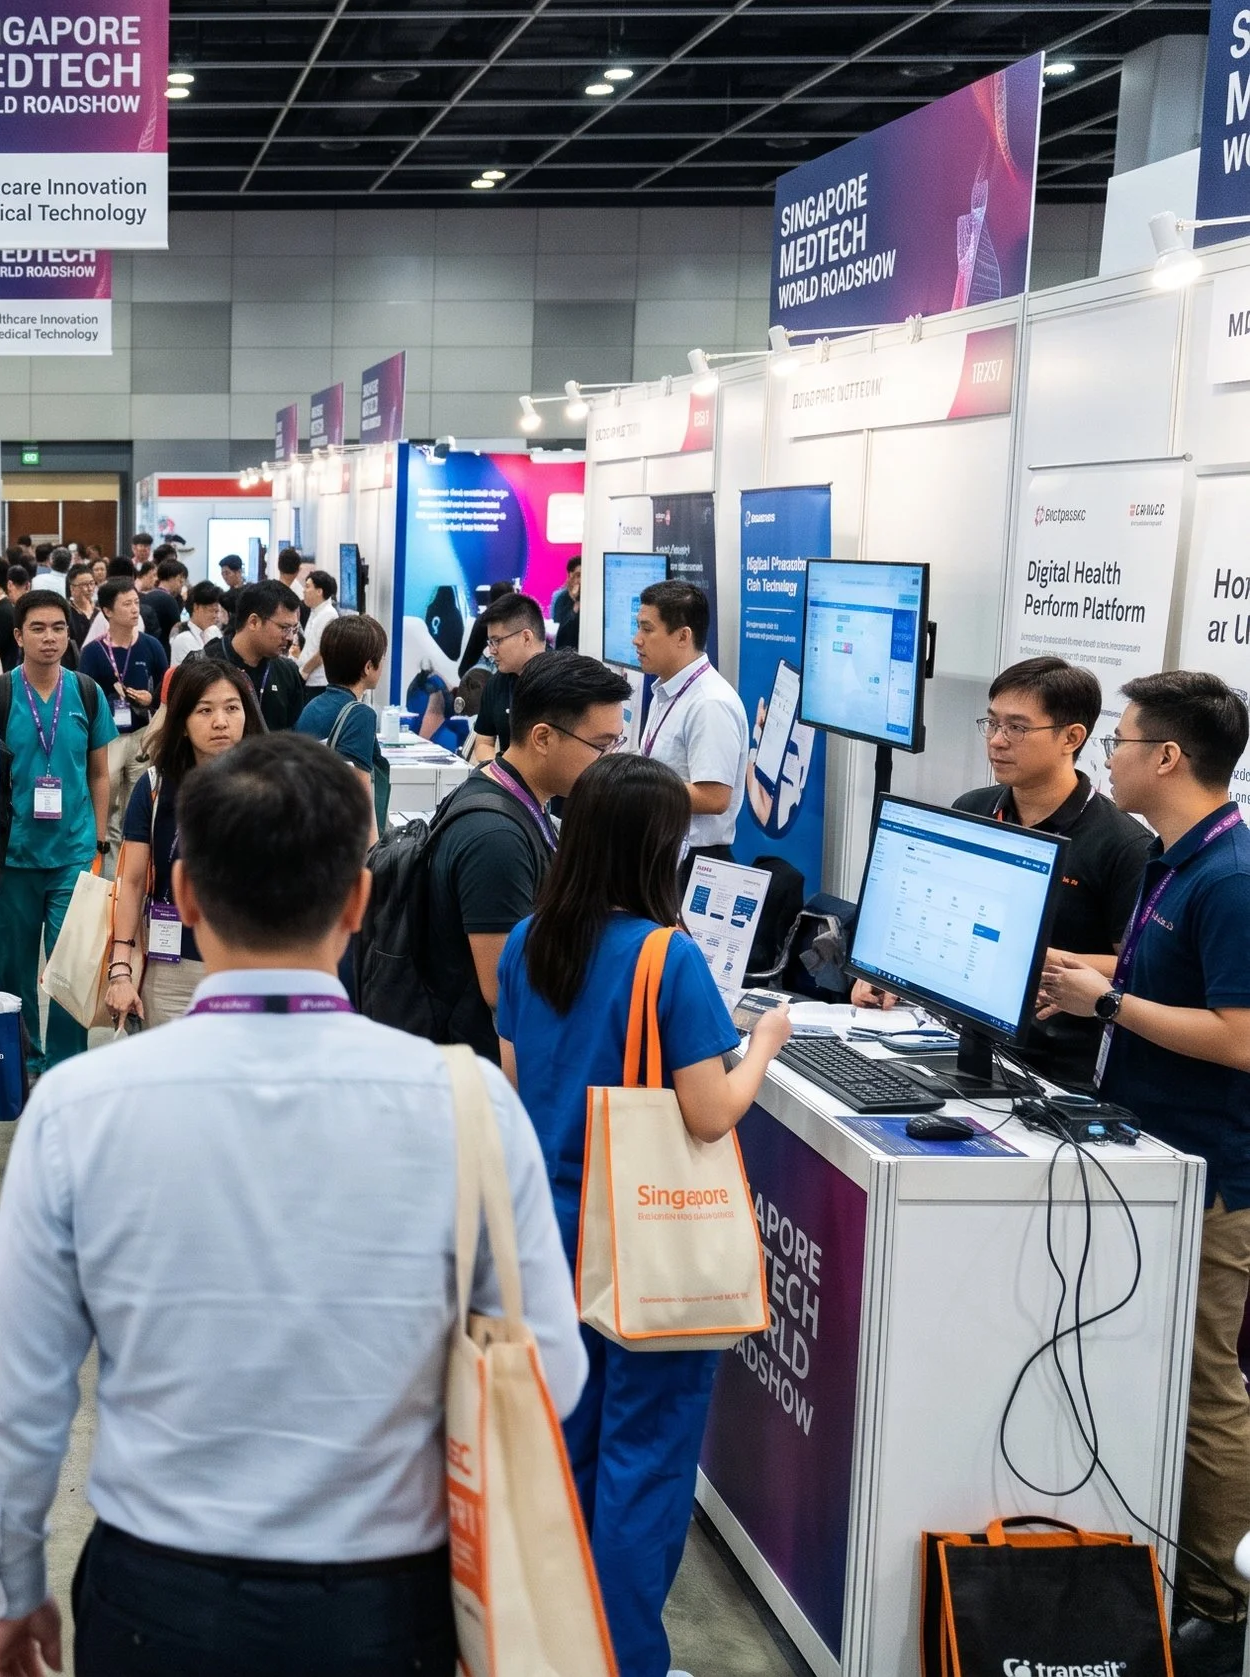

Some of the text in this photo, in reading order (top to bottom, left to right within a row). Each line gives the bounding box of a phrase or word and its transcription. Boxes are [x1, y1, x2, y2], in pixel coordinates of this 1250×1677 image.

[23, 95, 140, 113] ROADSHOW
[48, 177, 147, 195] Innovation
[37, 203, 147, 225] Technology
[780, 173, 868, 237] SINGAPORE
[779, 213, 867, 279] MEDTECH
[26, 265, 96, 278] ROADSHOW
[778, 249, 896, 310] WORLD ROADSHOW
[40, 313, 99, 325] Innovation
[34, 328, 99, 342] Technology
[1027, 559, 1121, 589] Digital Health
[1024, 593, 1146, 624] Perform Platform
[637, 1184, 729, 1210] Singapore
